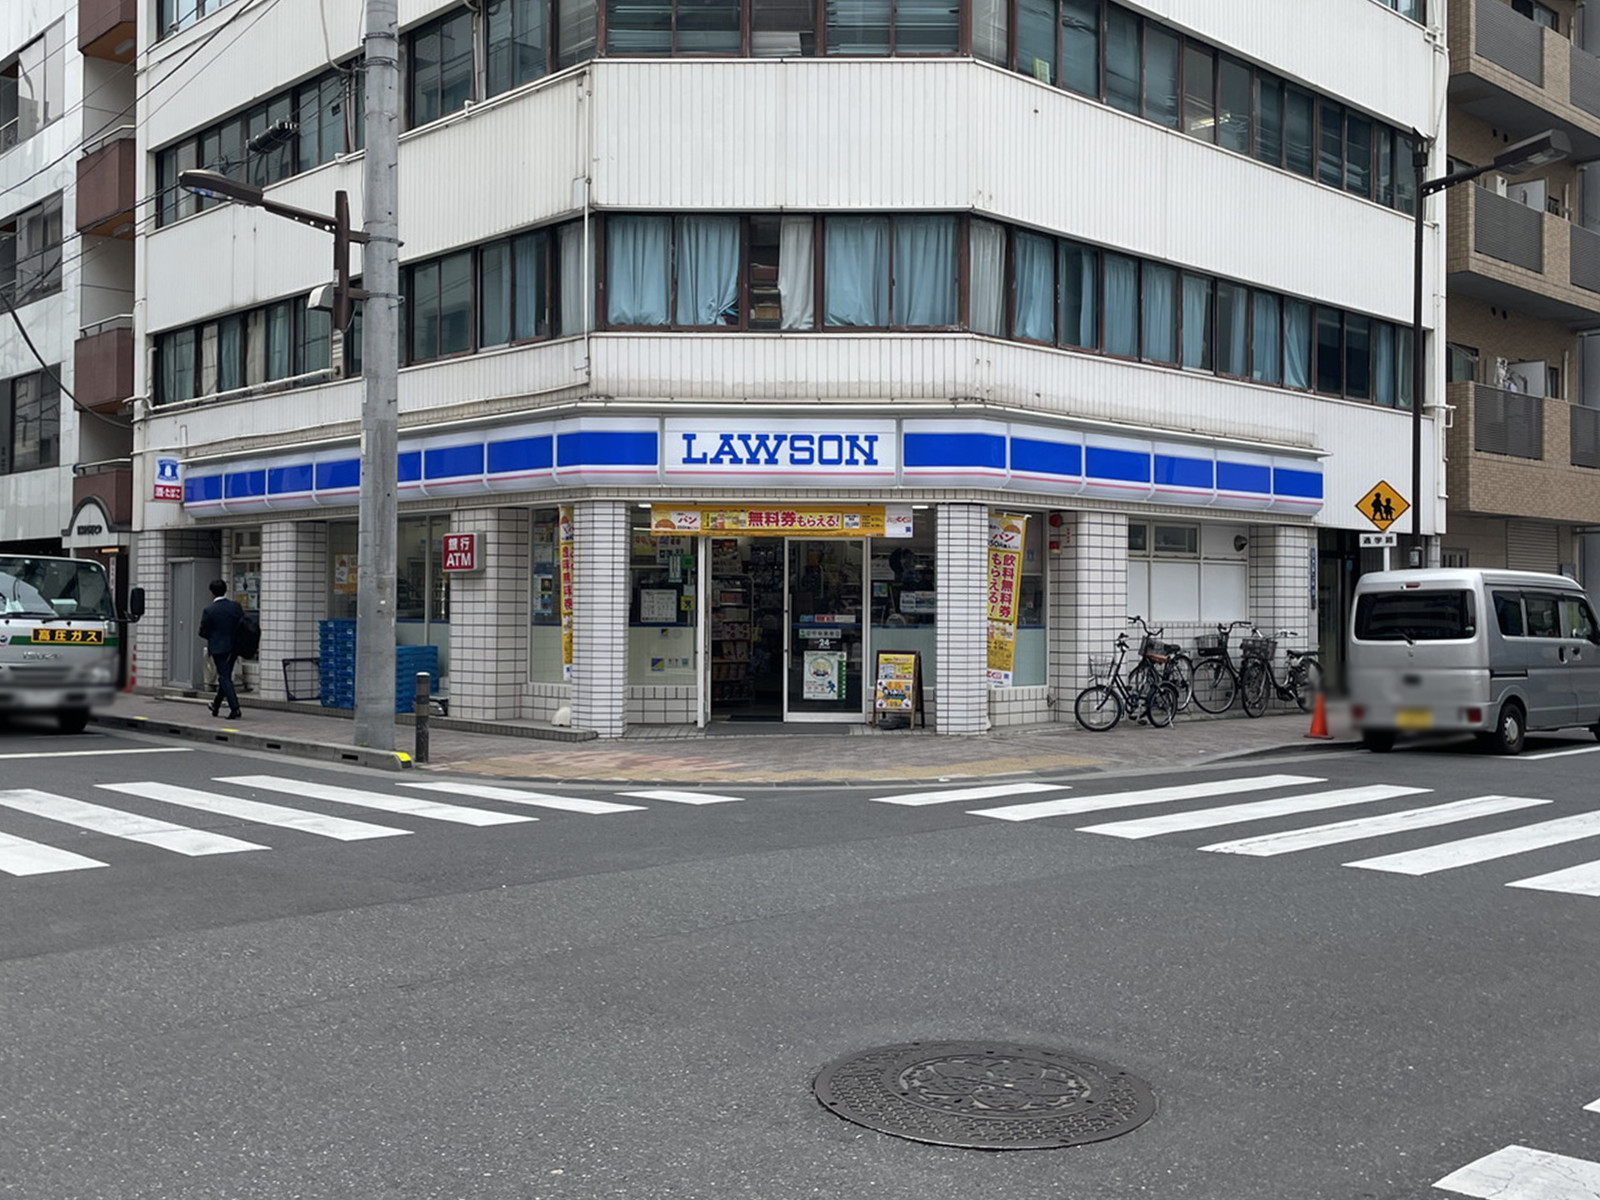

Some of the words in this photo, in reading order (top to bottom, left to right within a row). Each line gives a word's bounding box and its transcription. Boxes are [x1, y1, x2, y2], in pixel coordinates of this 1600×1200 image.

[682, 433, 879, 466] LAWSON
[678, 515, 697, 524] パン
[448, 537, 470, 550] 銀行
[446, 552, 471, 566] ATM
[998, 554, 1016, 618] 飲料無料券
[38, 630, 98, 642] 高圧ガス
